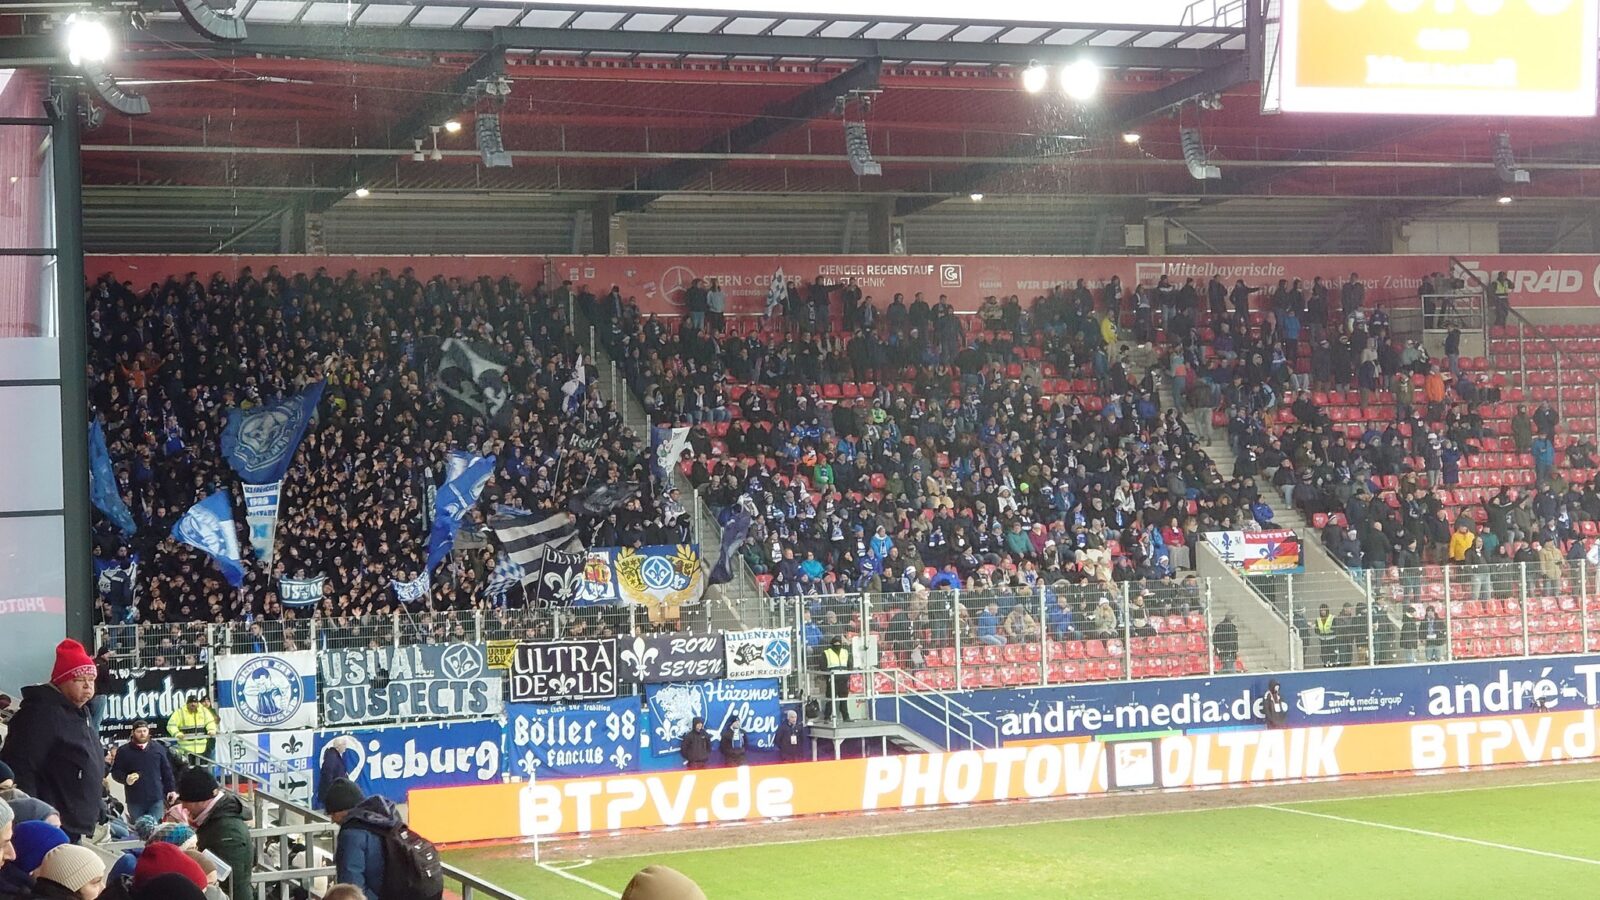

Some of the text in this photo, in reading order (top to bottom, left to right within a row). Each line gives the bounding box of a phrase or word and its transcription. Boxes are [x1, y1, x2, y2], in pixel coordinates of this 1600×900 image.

[818, 264, 934, 275] GIENGER REGENSTAUF
[1167, 262, 1285, 279] Mittelbayerische
[1383, 275, 1424, 290] Zeitun
[1245, 530, 1296, 540] AUSTRIA
[725, 631, 790, 642] LILIENFANS
[488, 648, 511, 656] URBA
[670, 637, 717, 655] ROW
[659, 658, 722, 677] SEVEN
[730, 669, 755, 678] GEGEN
[514, 671, 613, 697] DE LIS
[326, 680, 489, 723] SUSPECTS
[1002, 690, 1266, 735] andre-media.de
[514, 709, 636, 747] Böller 98
[706, 702, 779, 742] Llien
[294, 758, 307, 770] 98
[319, 735, 499, 783] Dieburg
[519, 766, 794, 836] BTPV.de
